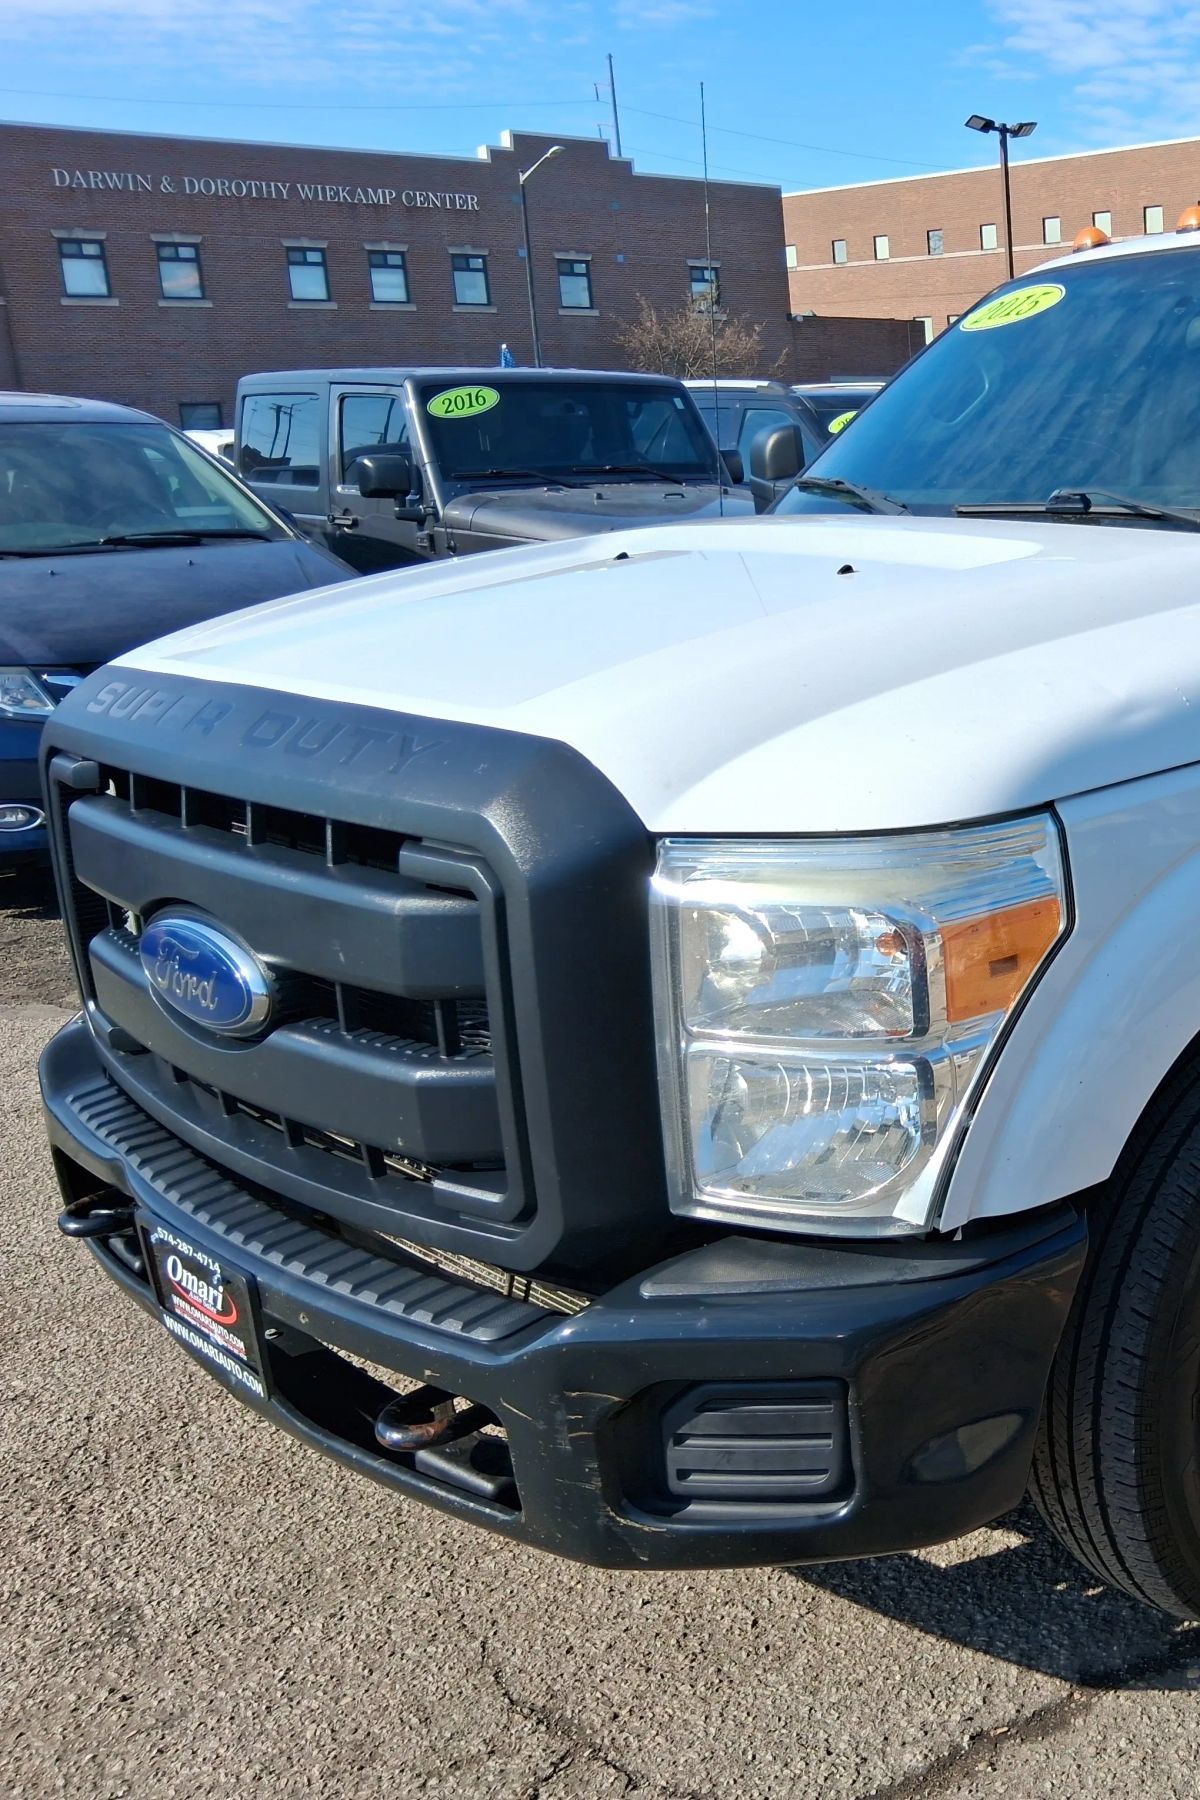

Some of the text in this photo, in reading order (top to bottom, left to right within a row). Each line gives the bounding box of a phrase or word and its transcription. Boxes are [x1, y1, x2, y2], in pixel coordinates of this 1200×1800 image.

[51, 168, 480, 211] DARWIN & DOROTHY WIEKAMP CENTER
[441, 388, 487, 414] 2016
[86, 681, 450, 775] SUPER DUTY
[154, 936, 219, 1011] Ford
[156, 1226, 221, 1274] 574-287-4714
[166, 1255, 225, 1311] Omari
[171, 1293, 246, 1352] WWW.OMARIAUTO.COM
[162, 1313, 265, 1398] WWW.OMARIAUTO.COM
